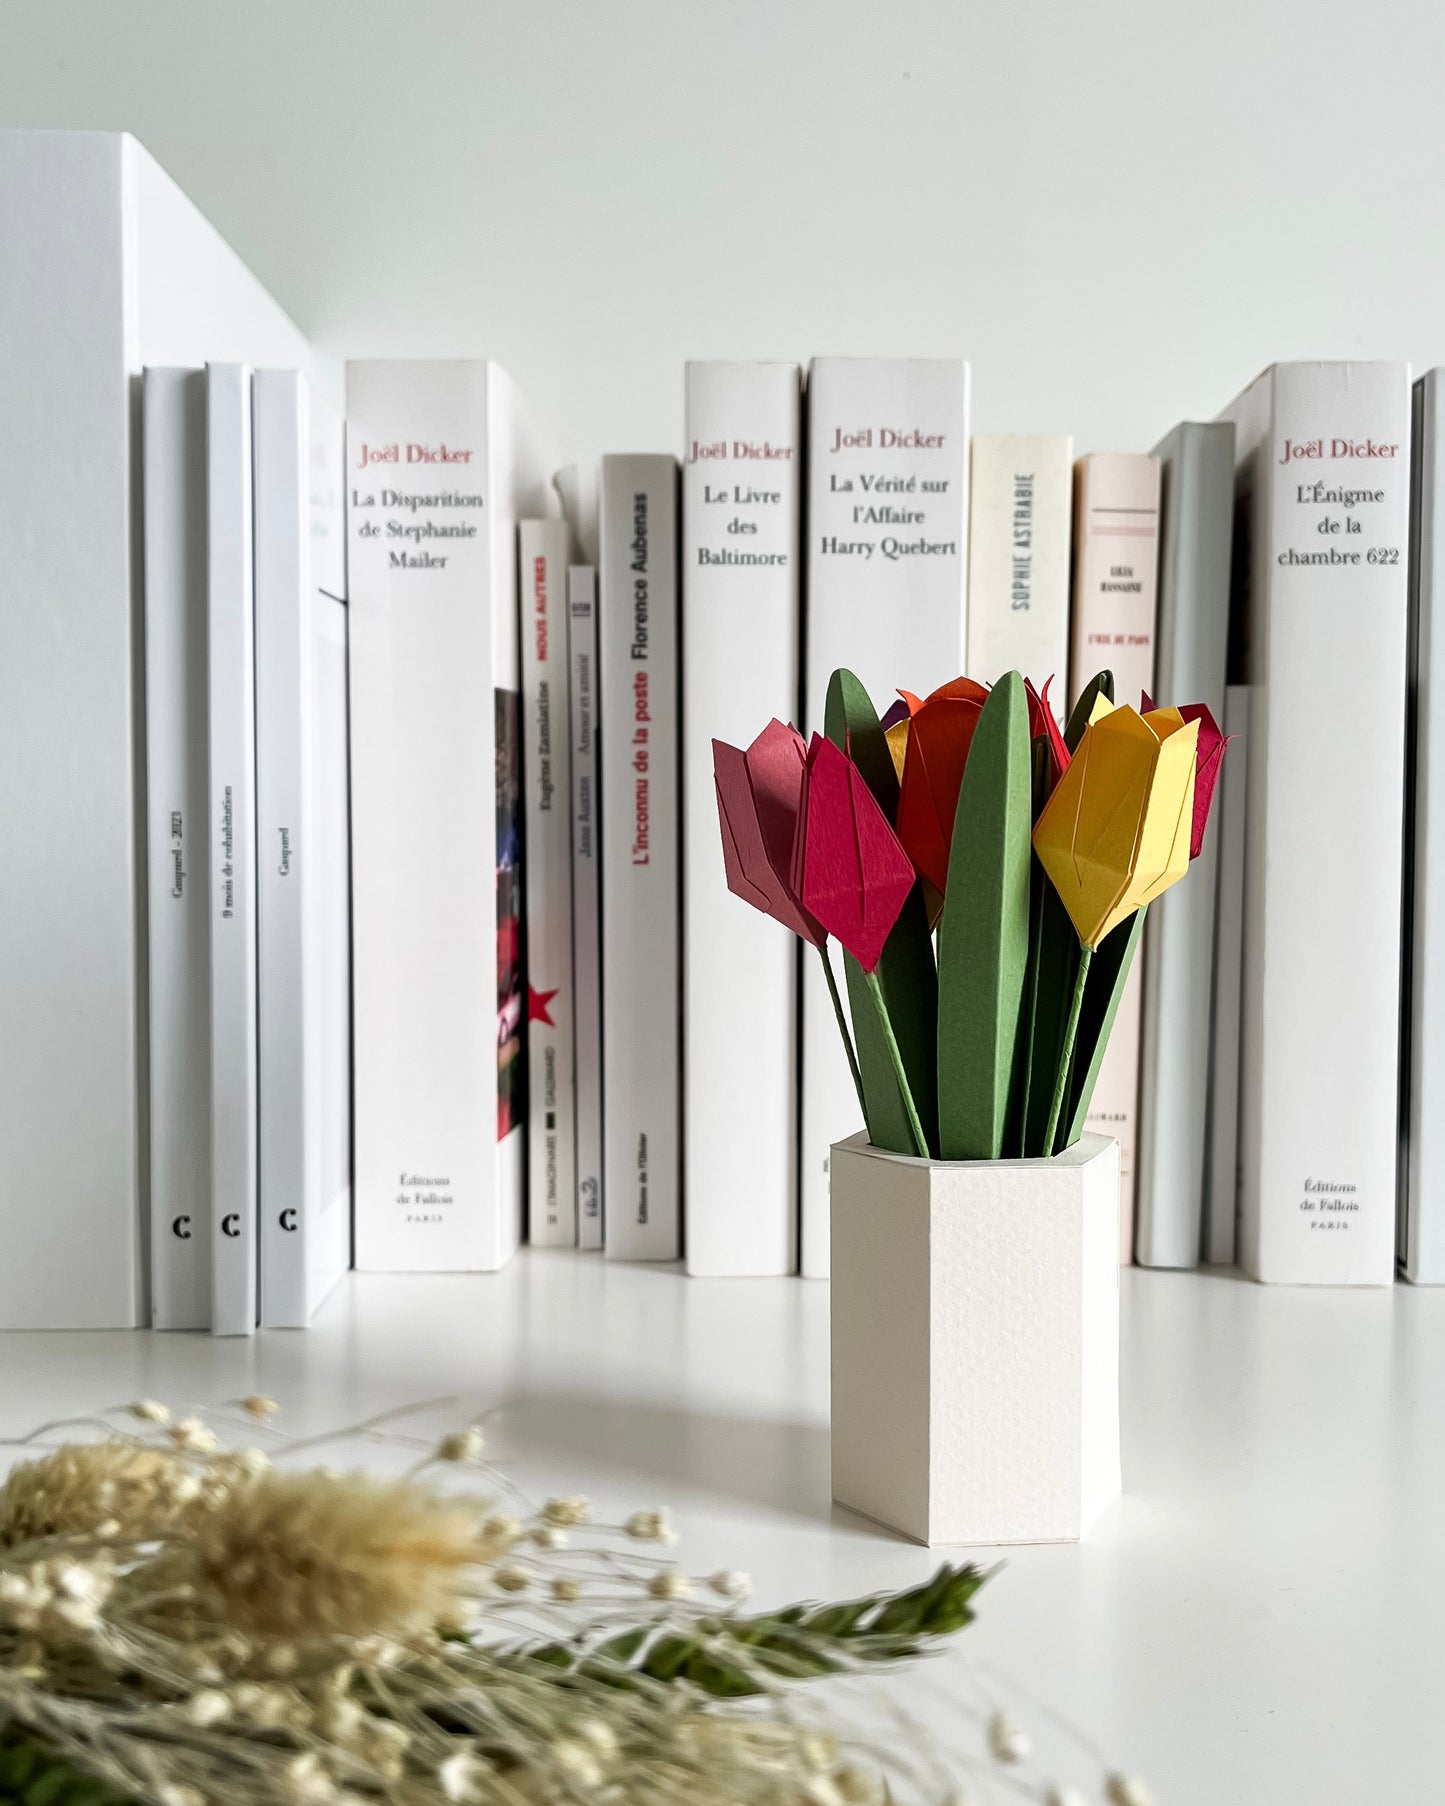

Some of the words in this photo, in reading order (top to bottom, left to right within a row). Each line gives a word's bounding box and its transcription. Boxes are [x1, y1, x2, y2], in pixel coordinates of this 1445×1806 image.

[686, 441, 727, 463] Joël
[733, 441, 793, 460] Dicker
[830, 428, 873, 453] Joël
[880, 428, 946, 449] Dicker
[1279, 439, 1323, 465] Joël
[1330, 438, 1399, 459] Dicker
[358, 443, 399, 469] Joël
[406, 443, 472, 463] Dicker
[704, 486, 728, 503] Le
[734, 485, 781, 503] Livre
[830, 474, 854, 493] La
[860, 474, 917, 494] Vérité
[920, 479, 949, 493] sur
[1296, 480, 1385, 509] L'Énigme
[352, 490, 375, 506] La
[382, 489, 483, 513] Disparition
[1013, 473, 1034, 548] ASTRABIE
[727, 518, 758, 534] des
[853, 505, 925, 524] l'Affaire
[1317, 516, 1340, 534] de
[1346, 516, 1362, 534] la
[359, 521, 380, 537] de
[387, 520, 477, 544] Stephanie
[631, 493, 648, 573] Aubenas
[389, 551, 448, 568] Mailer
[698, 548, 787, 566] Baltimore
[821, 536, 876, 559] Harry
[881, 536, 956, 560] Quebert
[1278, 547, 1360, 566] chambre
[1366, 547, 1399, 565] 622
[534, 556, 547, 614] AUTRES
[1012, 555, 1031, 611] SOPHIE
[631, 578, 648, 660] Florence
[535, 619, 548, 662] NOUS
[633, 672, 652, 722] poste
[632, 728, 649, 744] la
[632, 750, 649, 773] de
[633, 779, 649, 866] L'inconnu
[221, 861, 233, 877] de
[1304, 1175, 1357, 1193] Éditions
[1299, 1198, 1316, 1211] de
[1319, 1198, 1360, 1212] Fallois
[1310, 1220, 1350, 1231] PARIS
